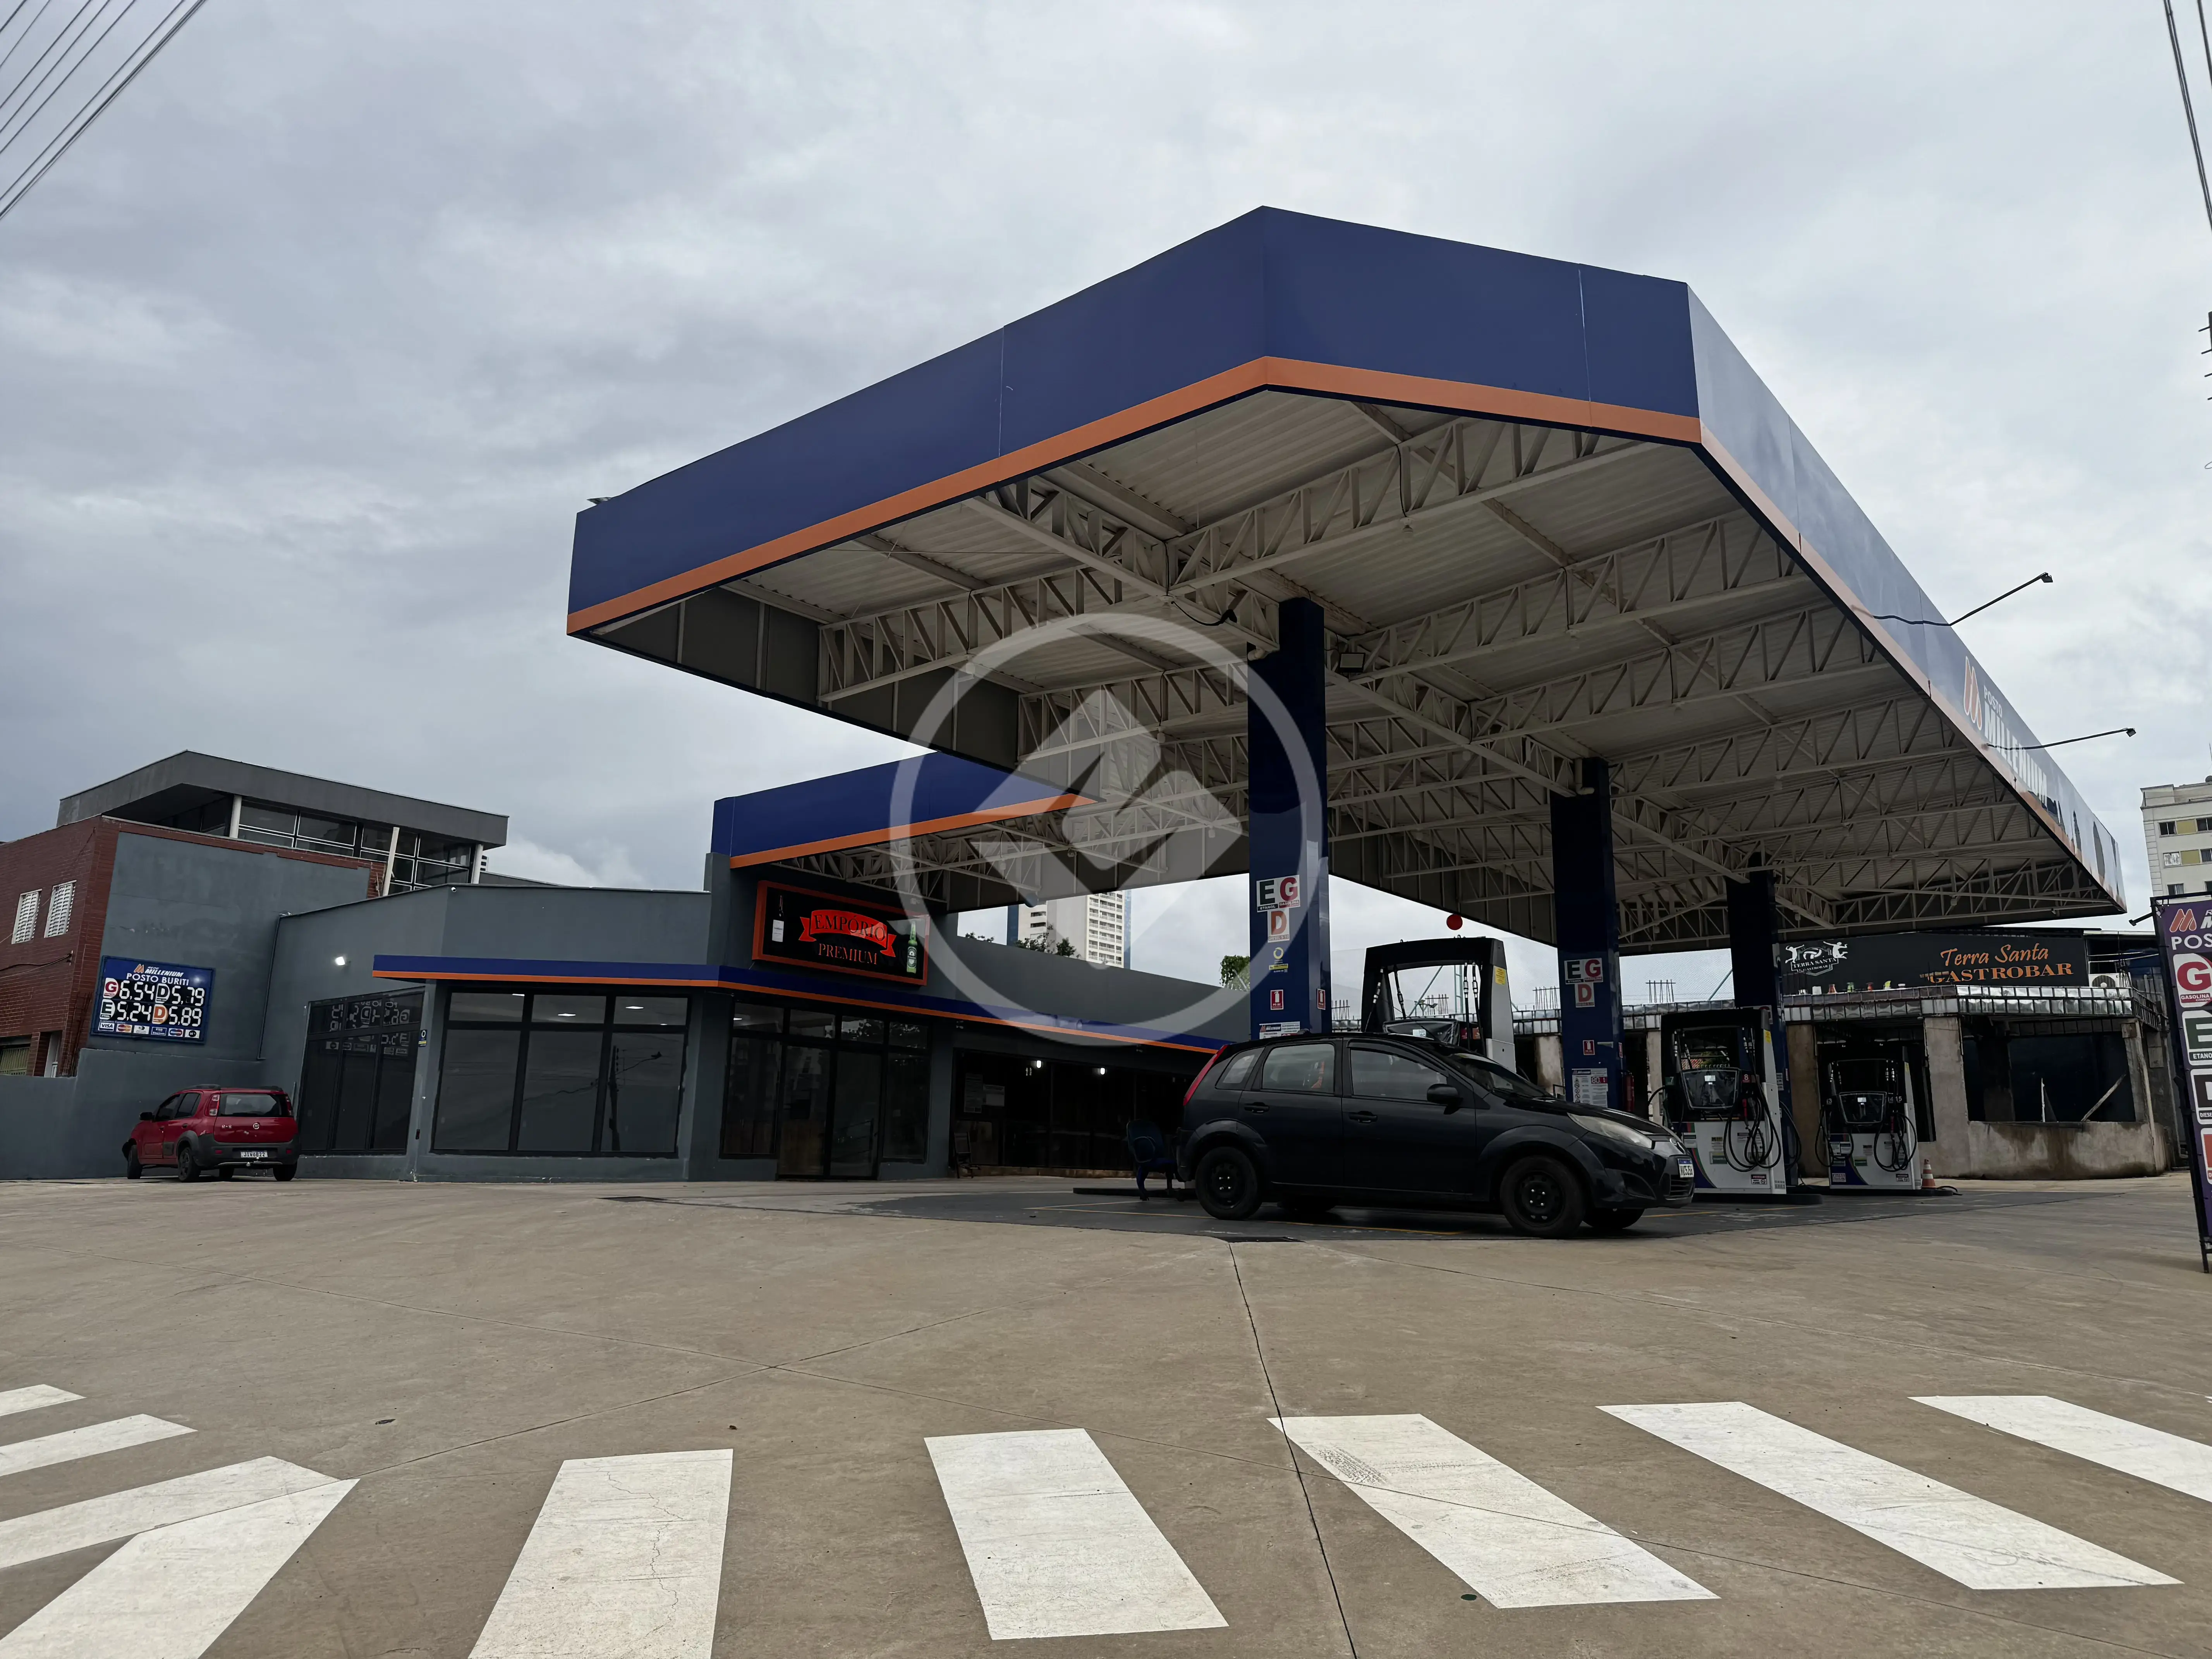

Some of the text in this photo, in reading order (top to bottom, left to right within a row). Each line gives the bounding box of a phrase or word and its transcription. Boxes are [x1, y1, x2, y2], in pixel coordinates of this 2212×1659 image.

[1984, 685, 2002, 718] POSTO
[1984, 701, 2047, 808] MILLENIUM
[1259, 877, 1298, 905] E G
[814, 913, 886, 942] EMPÓRIO
[1271, 910, 1287, 935] D
[818, 943, 877, 965] PREMIUM
[1940, 943, 2049, 966] Terra Santa
[126, 973, 189, 986] POSTO BURITI
[145, 969, 184, 977] MILLENIUM
[1567, 959, 1601, 979] E G
[2177, 962, 2212, 991] G
[105, 980, 204, 1006] G 6,54 D 5,79
[1578, 984, 1592, 1002] D
[101, 1001, 202, 1027] E 5,24 D 5,89
[2185, 1017, 2212, 1049] E
